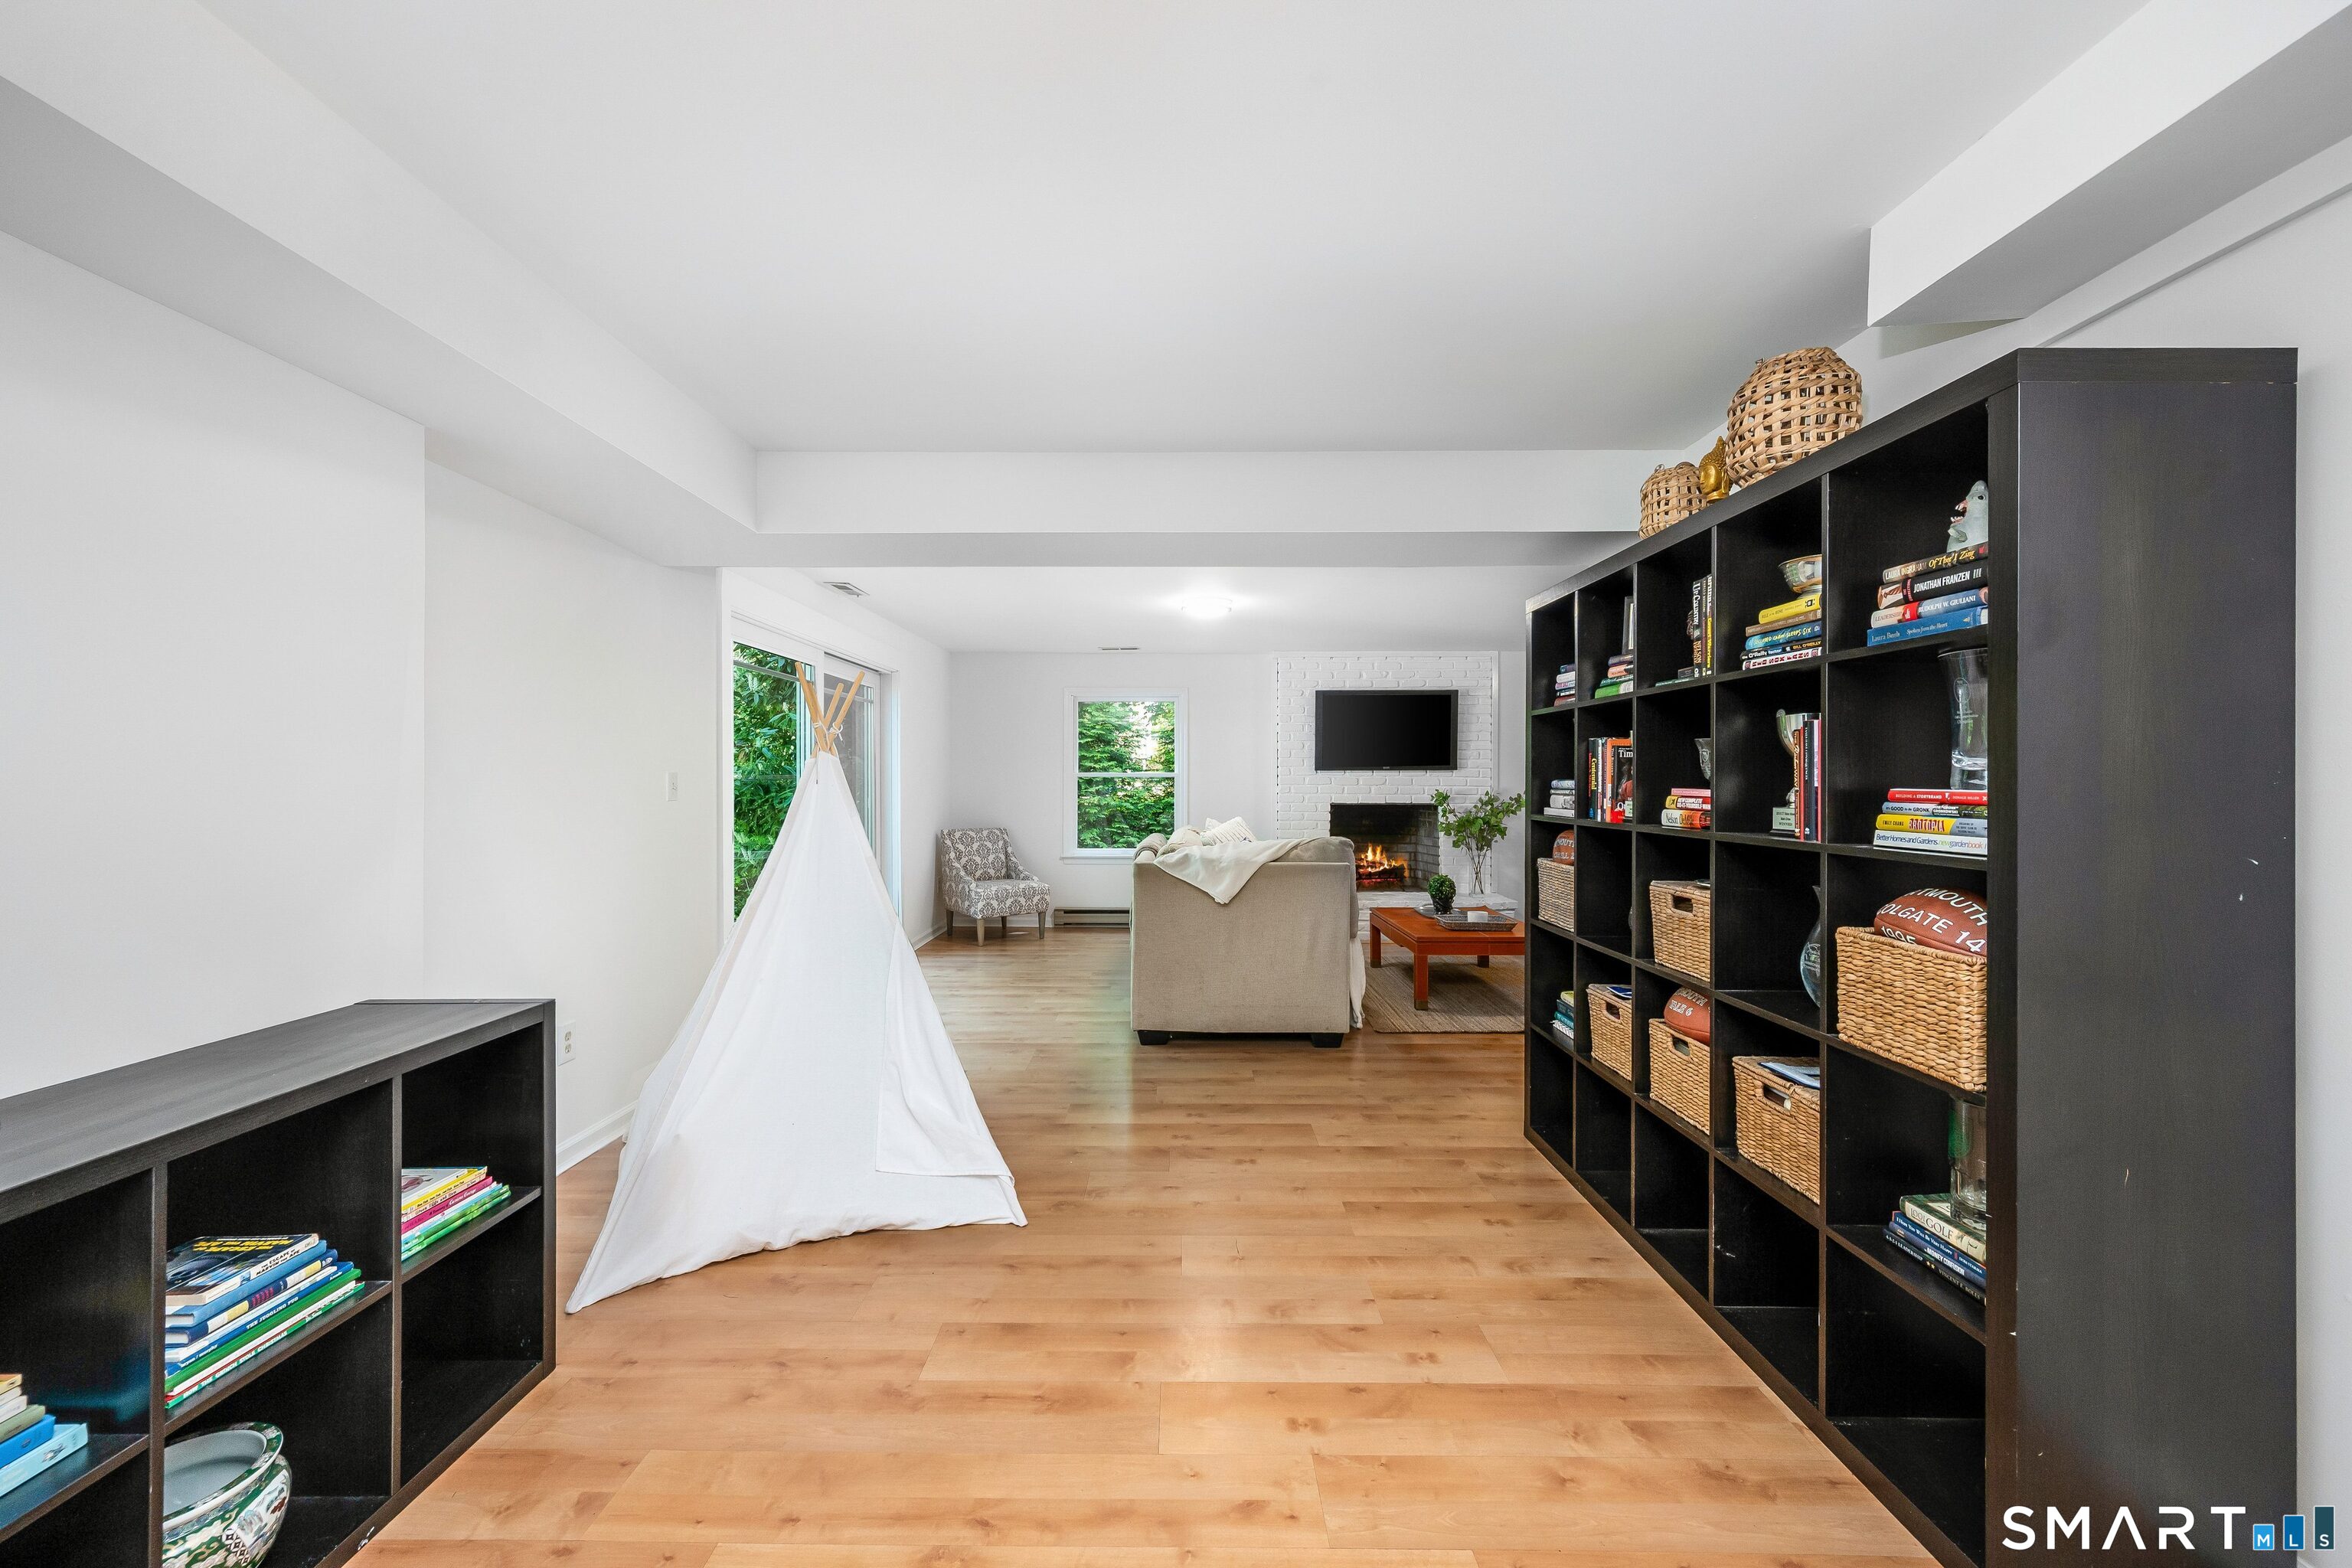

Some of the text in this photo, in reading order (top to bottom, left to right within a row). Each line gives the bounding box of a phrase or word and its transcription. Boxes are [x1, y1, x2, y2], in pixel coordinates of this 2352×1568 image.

[1929, 559, 1939, 569] Of
[1959, 550, 1975, 560] Zing
[1886, 562, 1927, 580] LAURA INGRAHAM
[1913, 570, 1971, 593] JONATHAN FRANZEN
[1919, 603, 1942, 613] RUDOLPH
[1950, 595, 1976, 607] GIULIANI
[1875, 611, 1902, 622] LEADERSHIP
[1871, 631, 1900, 642] Laura Bush
[1749, 650, 1767, 658] O'Reilly
[1619, 750, 1633, 758] Tim
[1666, 812, 1678, 824] Nelson
[1909, 818, 1945, 832] BROTOPIA
[1917, 837, 1938, 846] Gardens
[1904, 888, 1987, 926] TMOUTH
[1877, 903, 1986, 952] COLGATE 14
[1881, 926, 1917, 946] 1995
[1685, 1007, 1694, 1017] 6
[416, 1207, 427, 1215] Green
[1926, 1217, 1953, 1240] GOLF
[256, 1262, 279, 1276] MARVIN
[288, 1250, 300, 1258] APE
[269, 1253, 290, 1264] ESCAPE
[1926, 1247, 1943, 1263] MONEY
[1939, 1269, 1959, 1286] VINCENT
[1965, 1286, 1981, 1299] BOLES
[259, 1304, 286, 1323] JUGGLING
[287, 1297, 299, 1306] PUG
[214, 1364, 238, 1379] GRINCH
[239, 1352, 256, 1365] STOLE
[257, 1331, 288, 1353] CHRISTMAS
